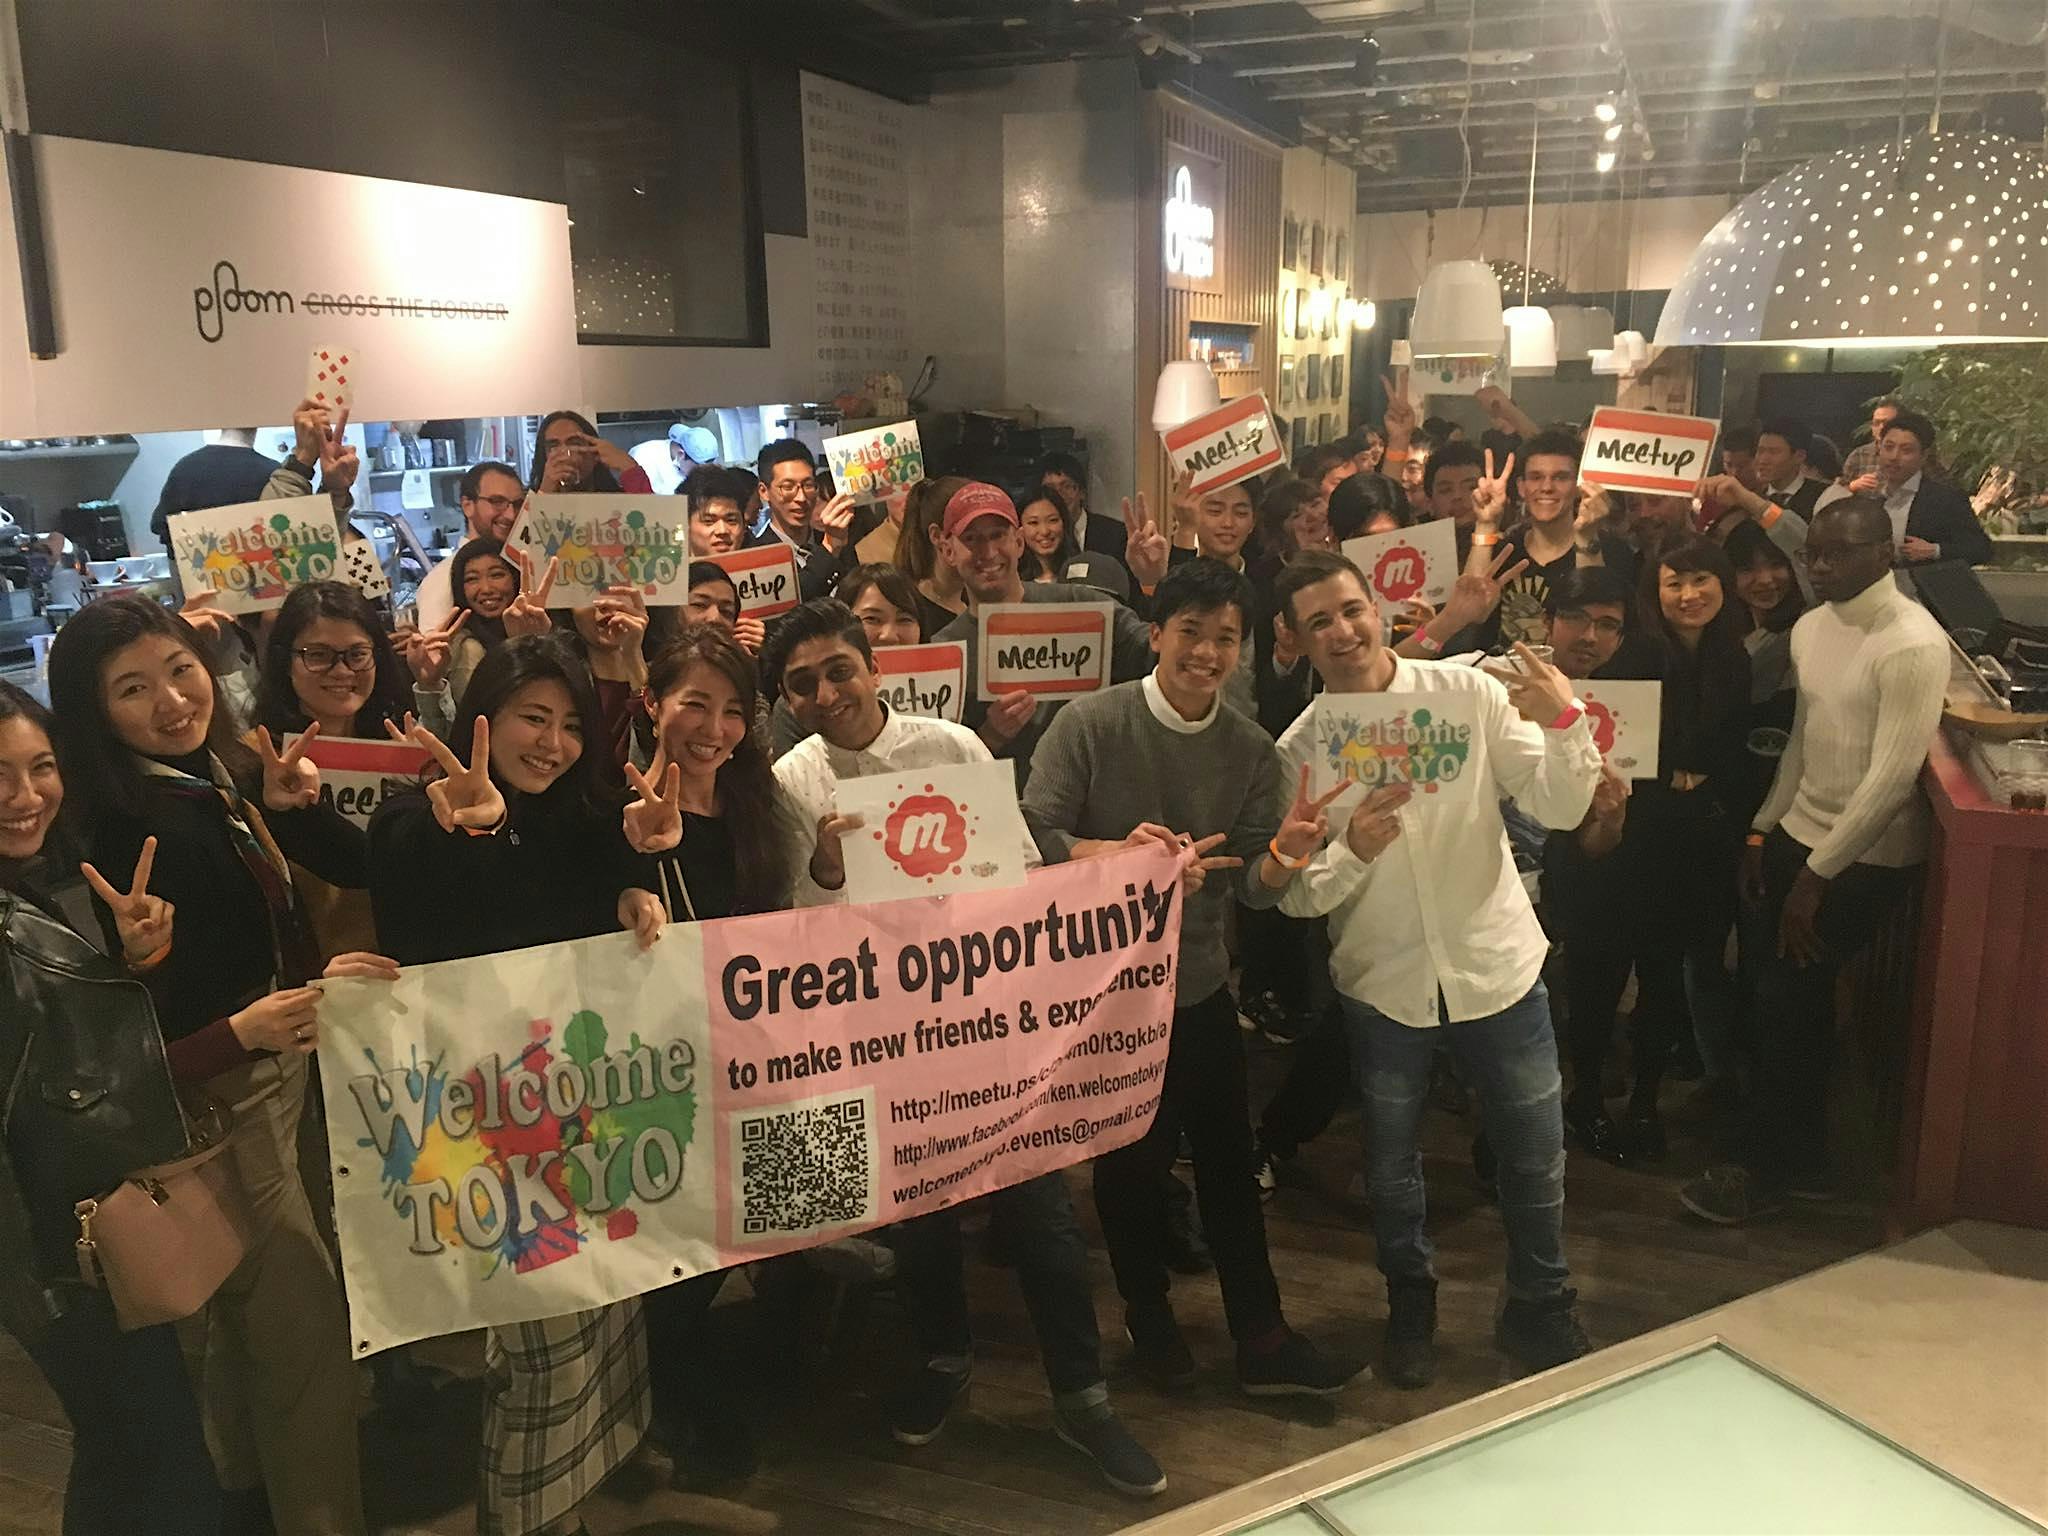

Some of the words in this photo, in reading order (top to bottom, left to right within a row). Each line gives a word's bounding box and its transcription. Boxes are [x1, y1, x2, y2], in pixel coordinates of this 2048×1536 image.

[305, 292, 381, 317] CROSS
[386, 296, 424, 319] THE
[430, 299, 507, 321] BORDER
[1596, 437, 1696, 477] Meetup
[176, 522, 335, 562] Welcome
[201, 552, 334, 593] TOKYO
[554, 556, 678, 586] TOKYO
[997, 638, 1092, 677] Meetup
[1317, 714, 1472, 748] Welcome
[1331, 752, 1463, 786] TOKYO
[721, 936, 880, 1021] Great
[727, 1057, 758, 1091] to
[766, 1041, 842, 1084] make
[849, 1031, 907, 1067] new
[914, 1007, 1009, 1054] friends
[1018, 999, 1040, 1034] &
[348, 1037, 696, 1156] Welcome
[393, 1126, 684, 1257] TOKYO
